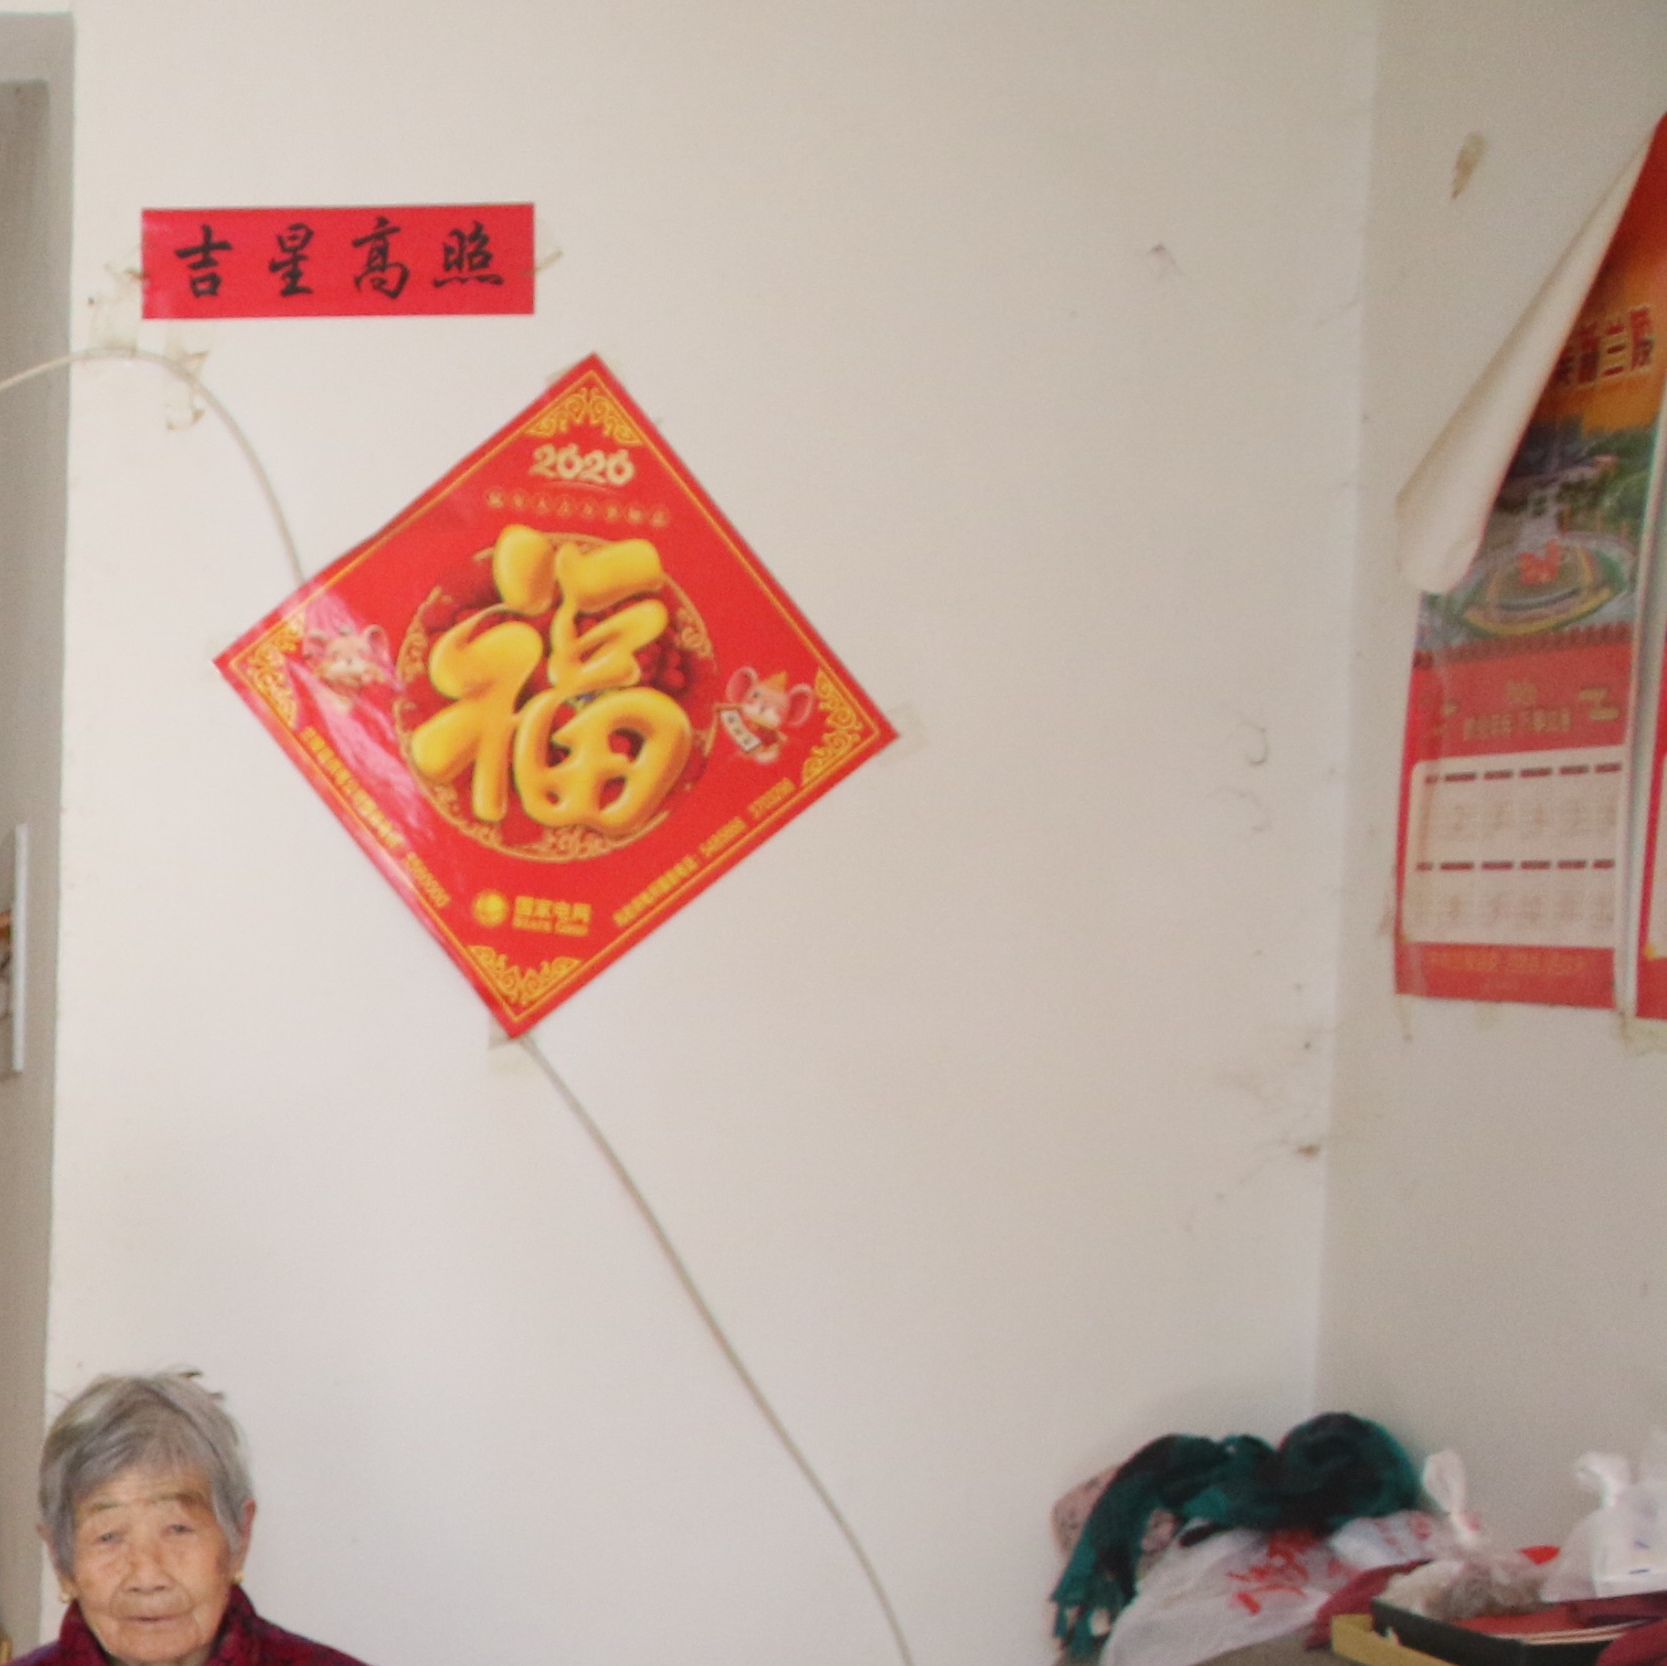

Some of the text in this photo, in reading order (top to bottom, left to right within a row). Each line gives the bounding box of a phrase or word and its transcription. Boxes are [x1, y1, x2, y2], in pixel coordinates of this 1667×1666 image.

[174, 214, 505, 299] 吉星高照
[528, 442, 636, 486] 2020
[411, 523, 693, 837] 福
